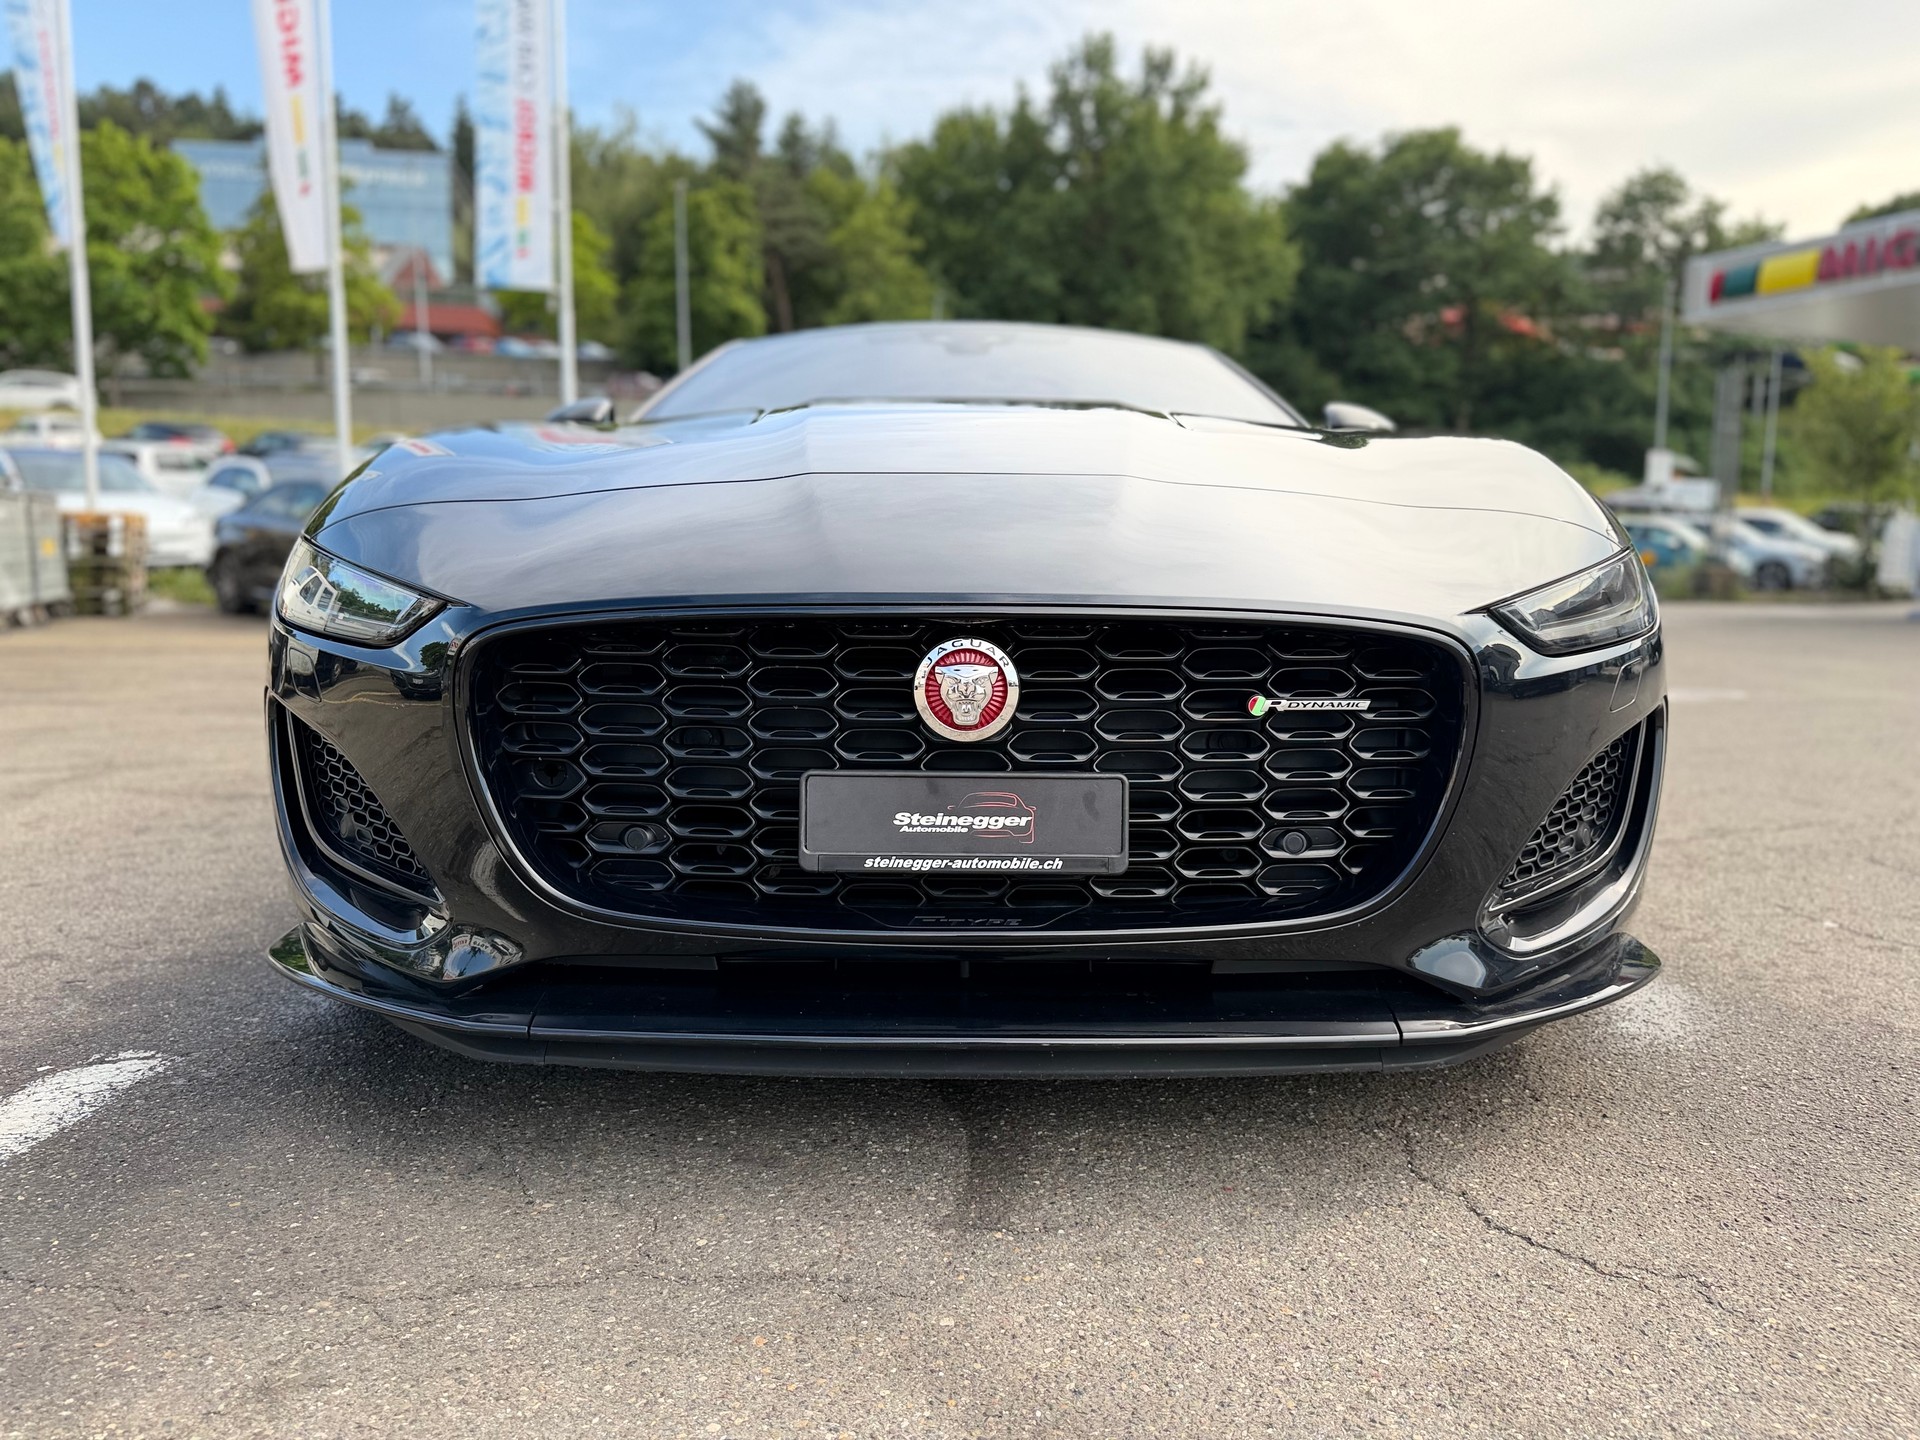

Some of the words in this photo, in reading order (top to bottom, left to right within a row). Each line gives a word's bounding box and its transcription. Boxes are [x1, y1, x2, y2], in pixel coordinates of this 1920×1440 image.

[926, 638, 1010, 668] JAGUAR
[892, 812, 1033, 829] Steinegger
[899, 825, 969, 833] Automobile
[863, 856, 1064, 871] steinegger-automobile.ch
